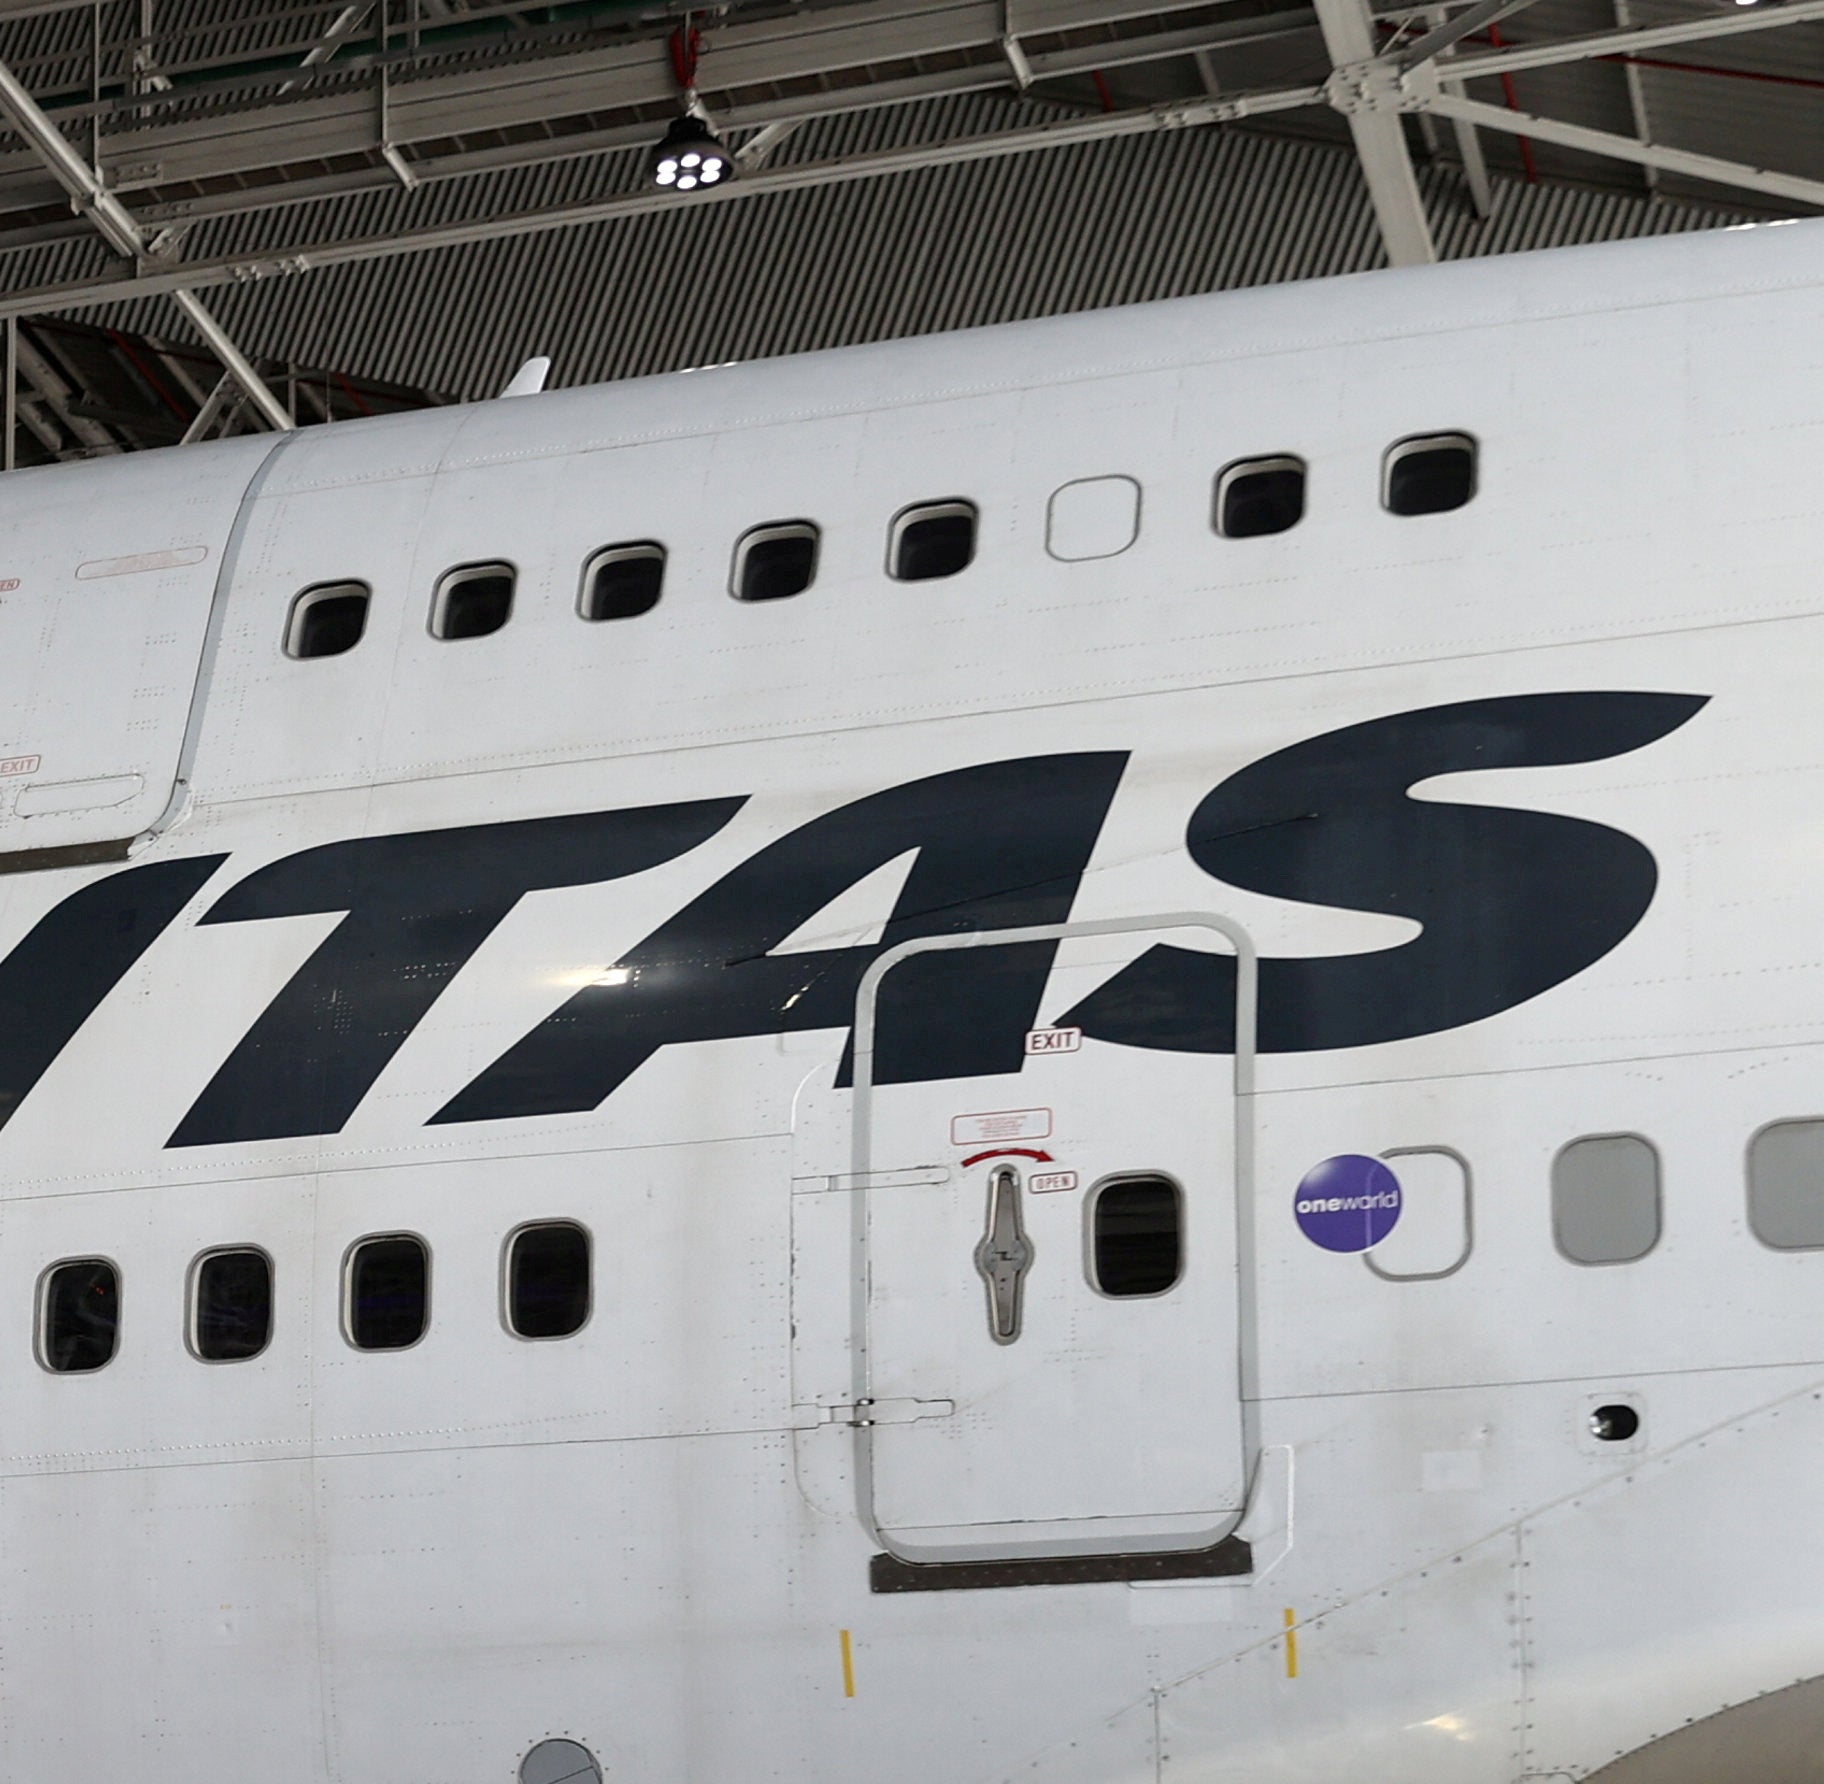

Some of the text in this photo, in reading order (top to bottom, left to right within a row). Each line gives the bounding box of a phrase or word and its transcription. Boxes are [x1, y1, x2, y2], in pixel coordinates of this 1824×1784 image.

[0, 758, 35, 774] EXIT
[1030, 1031, 1074, 1051] EXIT
[1036, 1175, 1070, 1190] OPEN
[1296, 1189, 1399, 1215] oneworld
